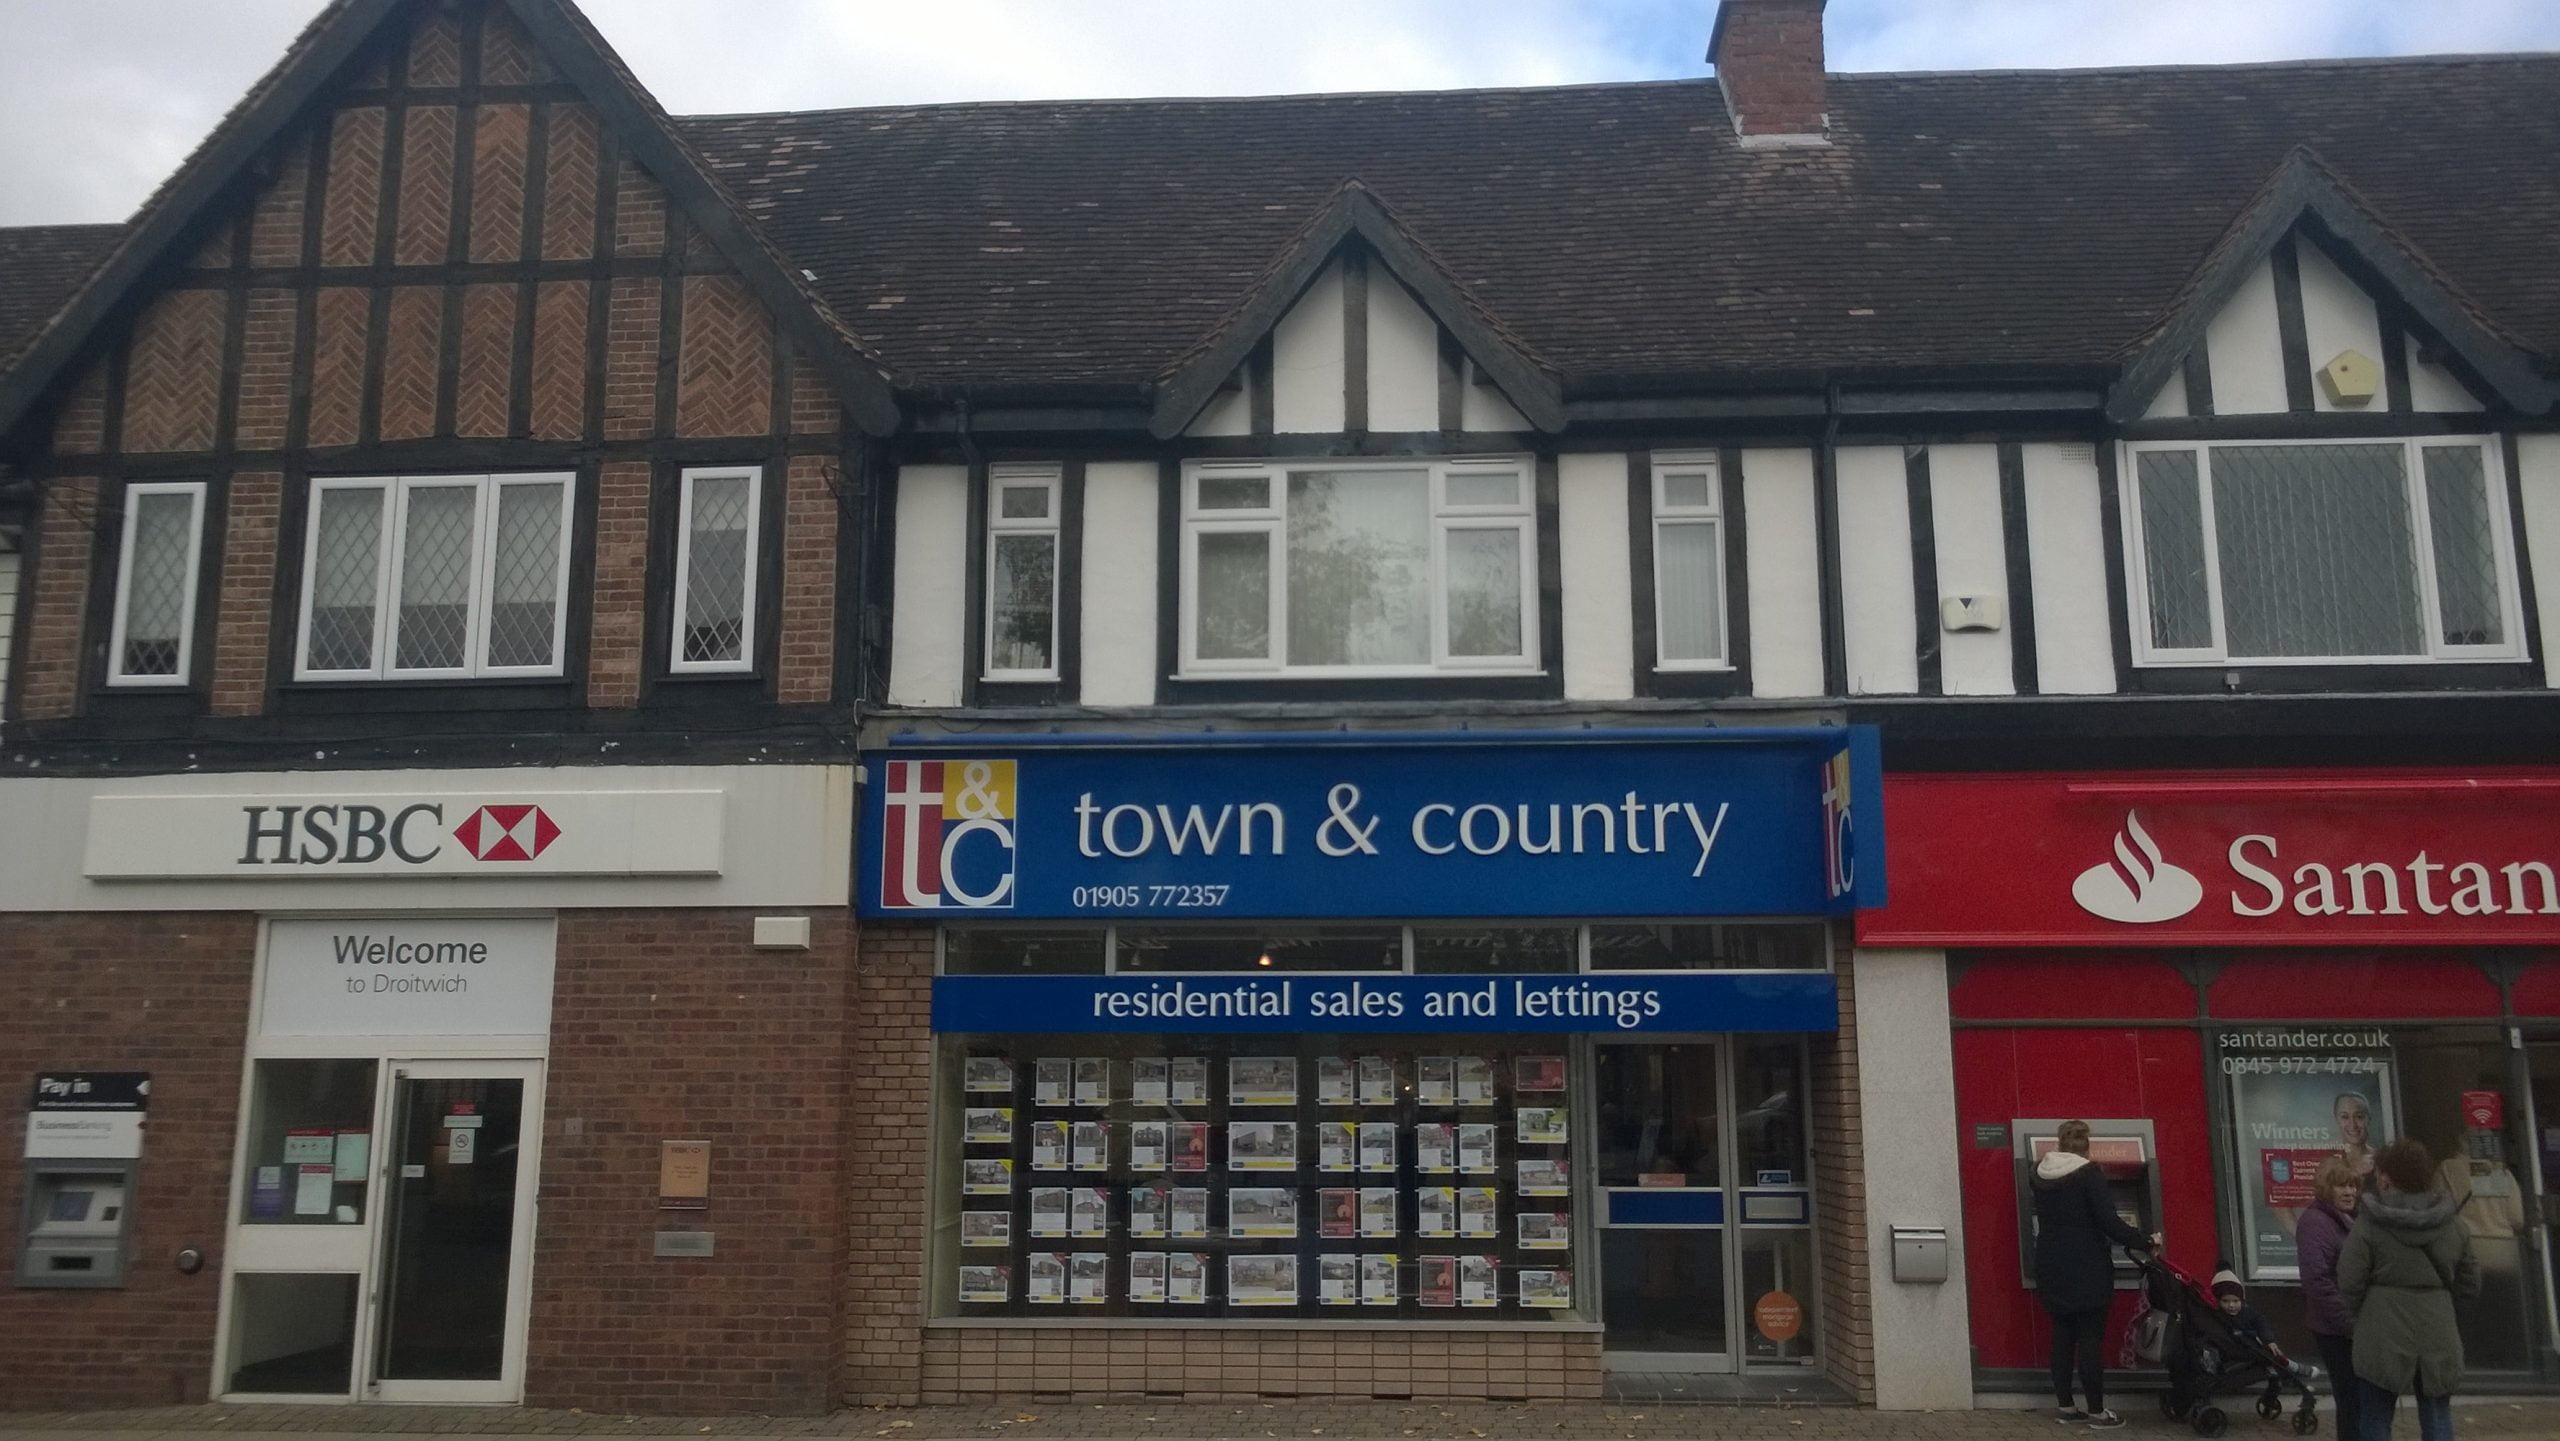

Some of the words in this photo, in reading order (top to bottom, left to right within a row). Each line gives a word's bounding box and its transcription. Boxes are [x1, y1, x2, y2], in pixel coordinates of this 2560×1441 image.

[237, 803, 443, 865] HSBC
[1073, 792, 1284, 858] town
[1315, 783, 1381, 857] &
[1411, 790, 1730, 877] country
[2228, 834, 2560, 916] Santan
[1072, 885, 1139, 907] 01905
[1148, 884, 1230, 906] 772357
[333, 935, 487, 965] Welcome
[346, 975, 366, 993] to
[373, 973, 467, 993] Droitwich
[1093, 981, 1291, 1018] residential
[1310, 981, 1403, 1018] sales
[1423, 981, 1496, 1018] and
[1515, 981, 1661, 1028] lettings
[2219, 1028, 2391, 1048] santander.co.uk
[2222, 1057, 2272, 1075] 0845
[2279, 1057, 2318, 1075] 972
[2324, 1056, 2375, 1075] 4724
[40, 1078, 73, 1096] Pay
[72, 1078, 91, 1093] in
[2250, 1122, 2330, 1140] Winners
